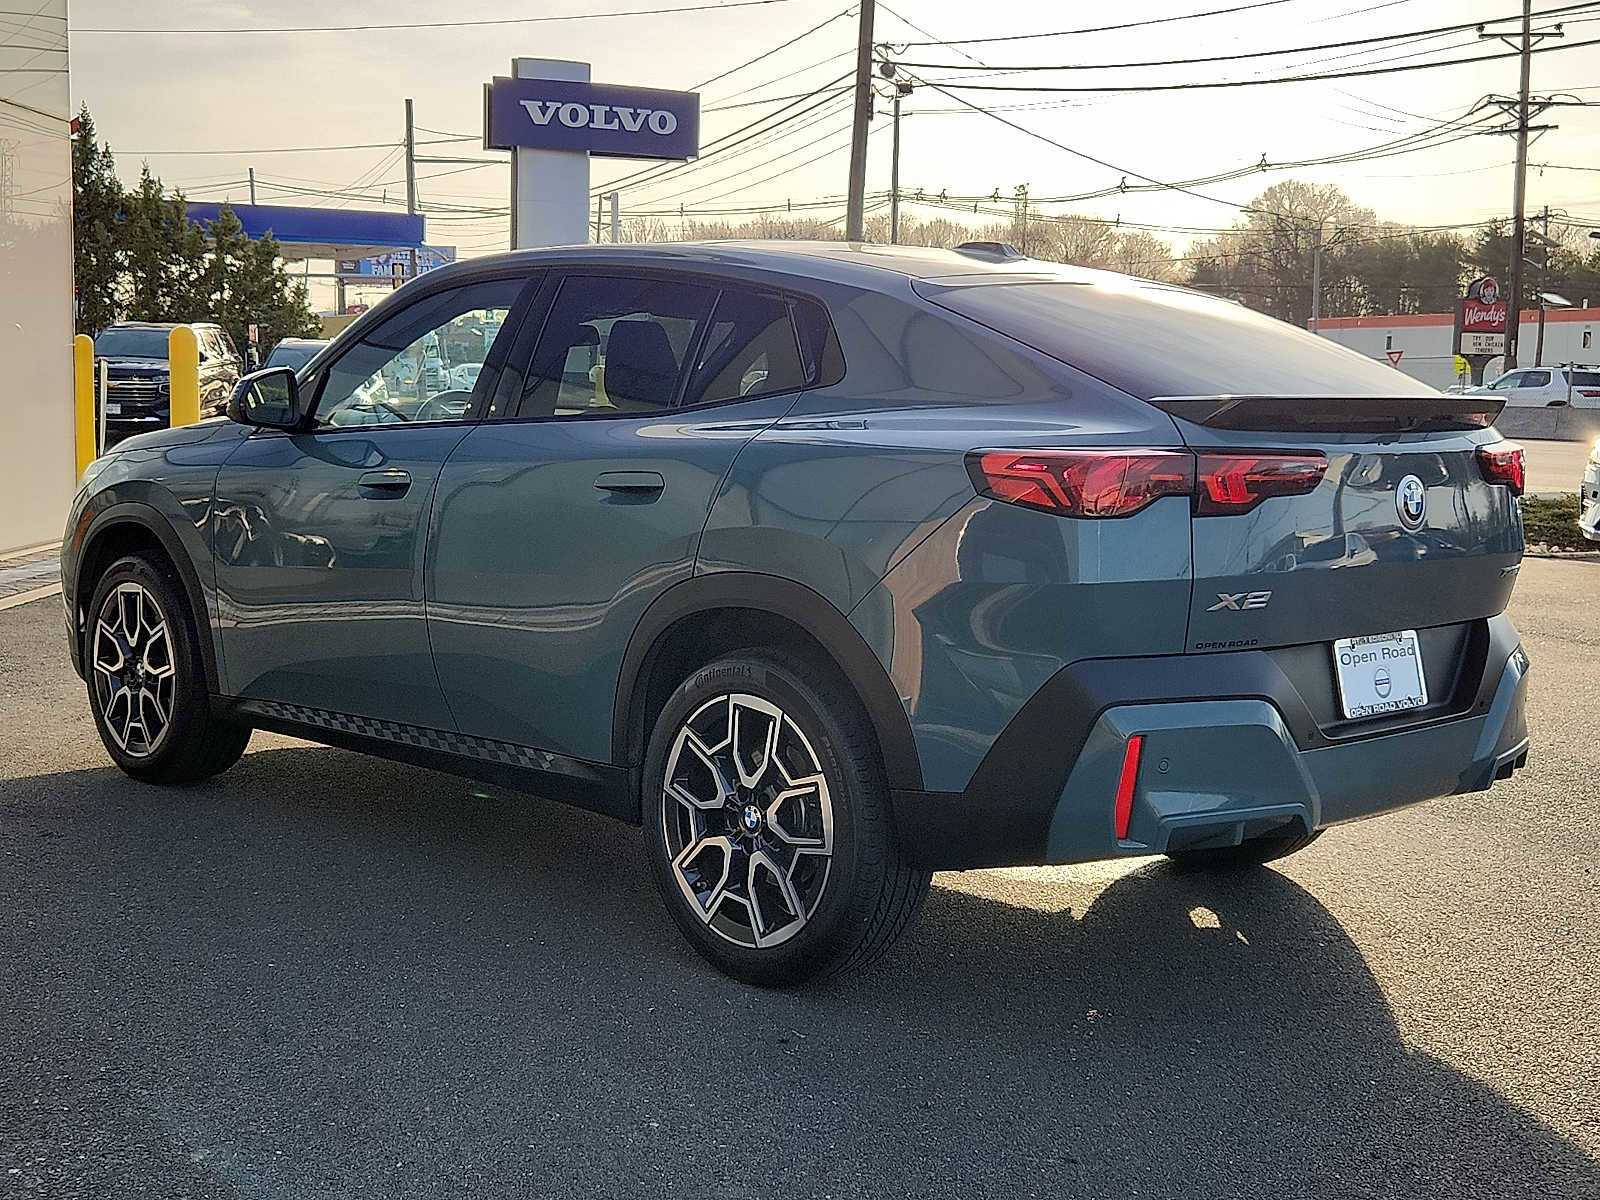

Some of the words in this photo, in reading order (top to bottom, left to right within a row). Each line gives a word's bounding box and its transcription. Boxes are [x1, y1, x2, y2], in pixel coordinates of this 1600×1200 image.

[519, 100, 678, 135] VOLVO
[1464, 305, 1506, 327] Wendy's
[1206, 590, 1272, 612] X2
[1195, 641, 1228, 649] OPEN
[1228, 639, 1258, 648] ROAD
[1340, 651, 1378, 668] Open
[1381, 645, 1416, 660] Road
[694, 664, 746, 688] Continental
[1349, 705, 1373, 717] OPEN
[1373, 701, 1397, 713] ROAD
[1397, 697, 1424, 709] VOLVO
